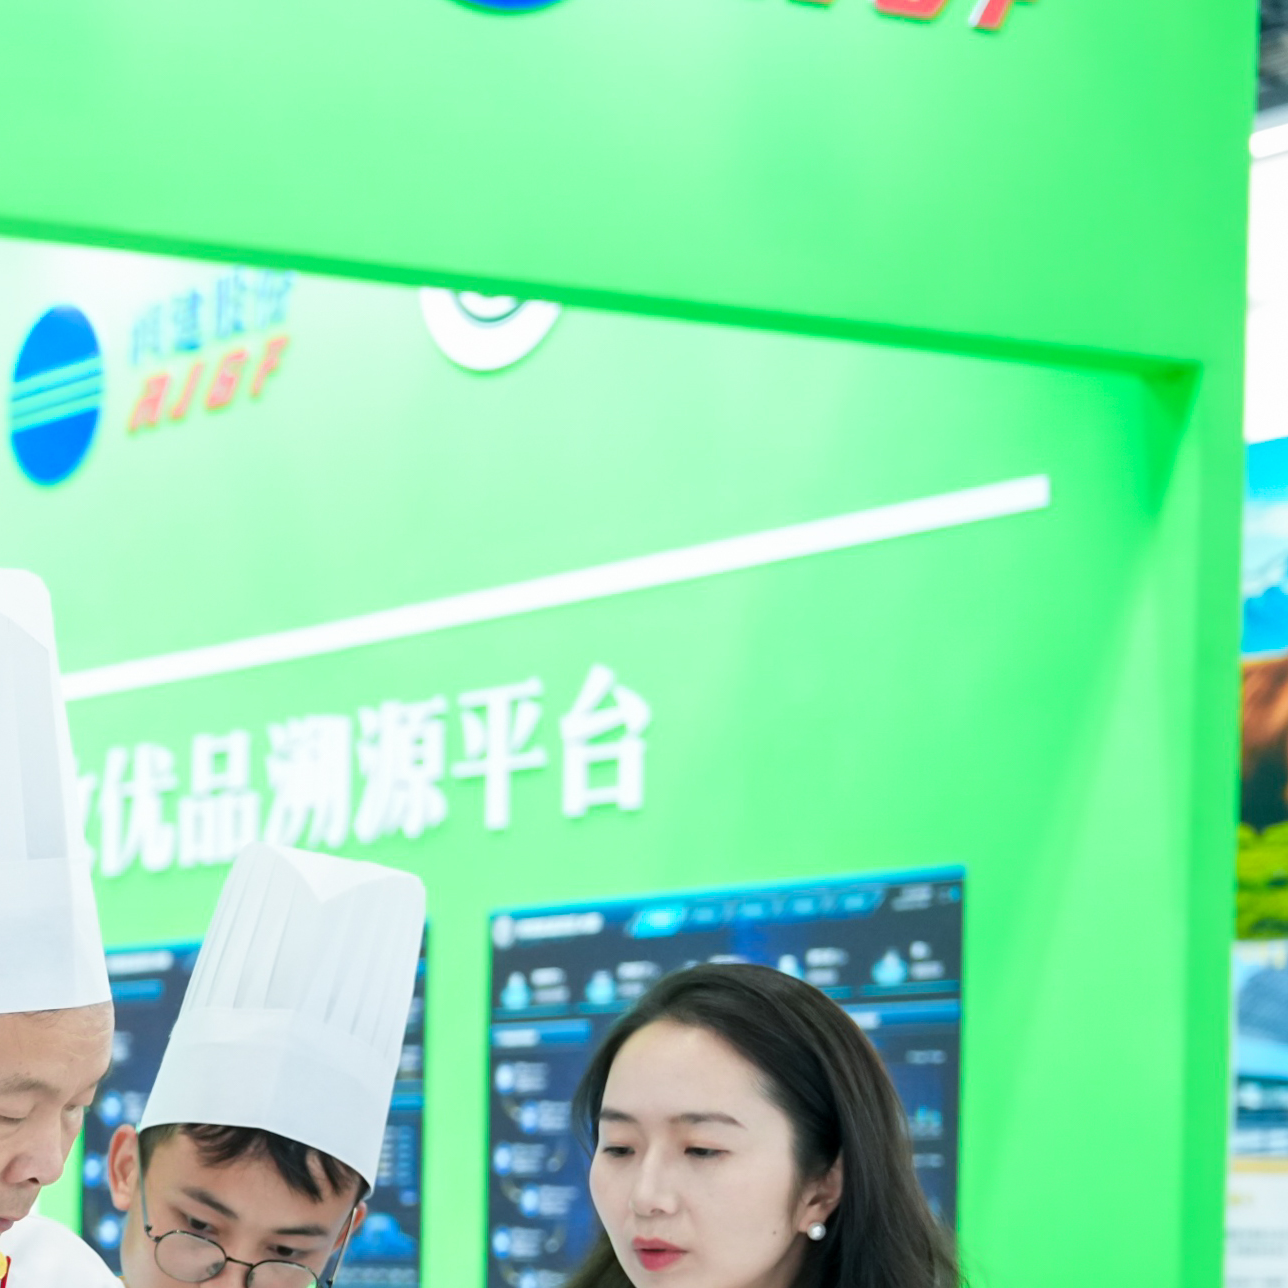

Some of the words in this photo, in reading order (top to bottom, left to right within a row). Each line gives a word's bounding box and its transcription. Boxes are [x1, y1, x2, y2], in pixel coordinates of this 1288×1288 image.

[77, 663, 651, 878] 优品溯源平台
